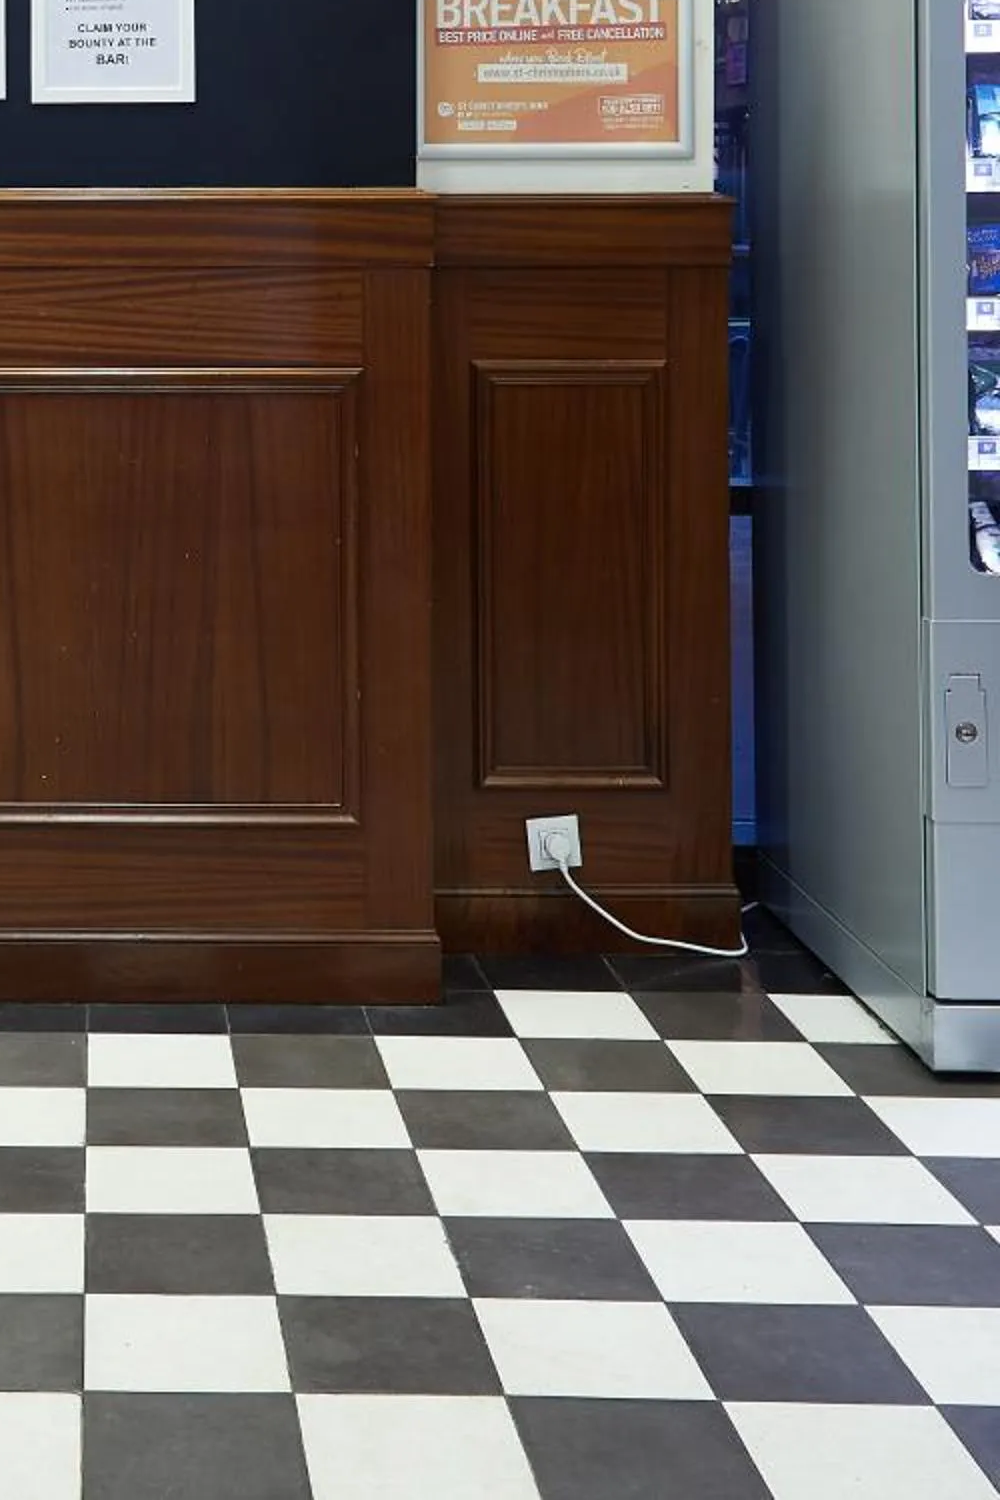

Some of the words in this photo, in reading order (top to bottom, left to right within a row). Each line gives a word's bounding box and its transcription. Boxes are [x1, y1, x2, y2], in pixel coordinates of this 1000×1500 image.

[77, 23, 113, 33] CLAIM
[116, 22, 148, 33] YOUR
[439, 31, 464, 44] BEST
[467, 30, 497, 43] PRICE
[499, 29, 538, 42] ONLINE
[558, 28, 585, 41] FREE
[587, 26, 665, 40] CANCELLATION
[69, 38, 115, 49] BOUNTY
[117, 37, 132, 48] AT
[135, 37, 157, 47] THE
